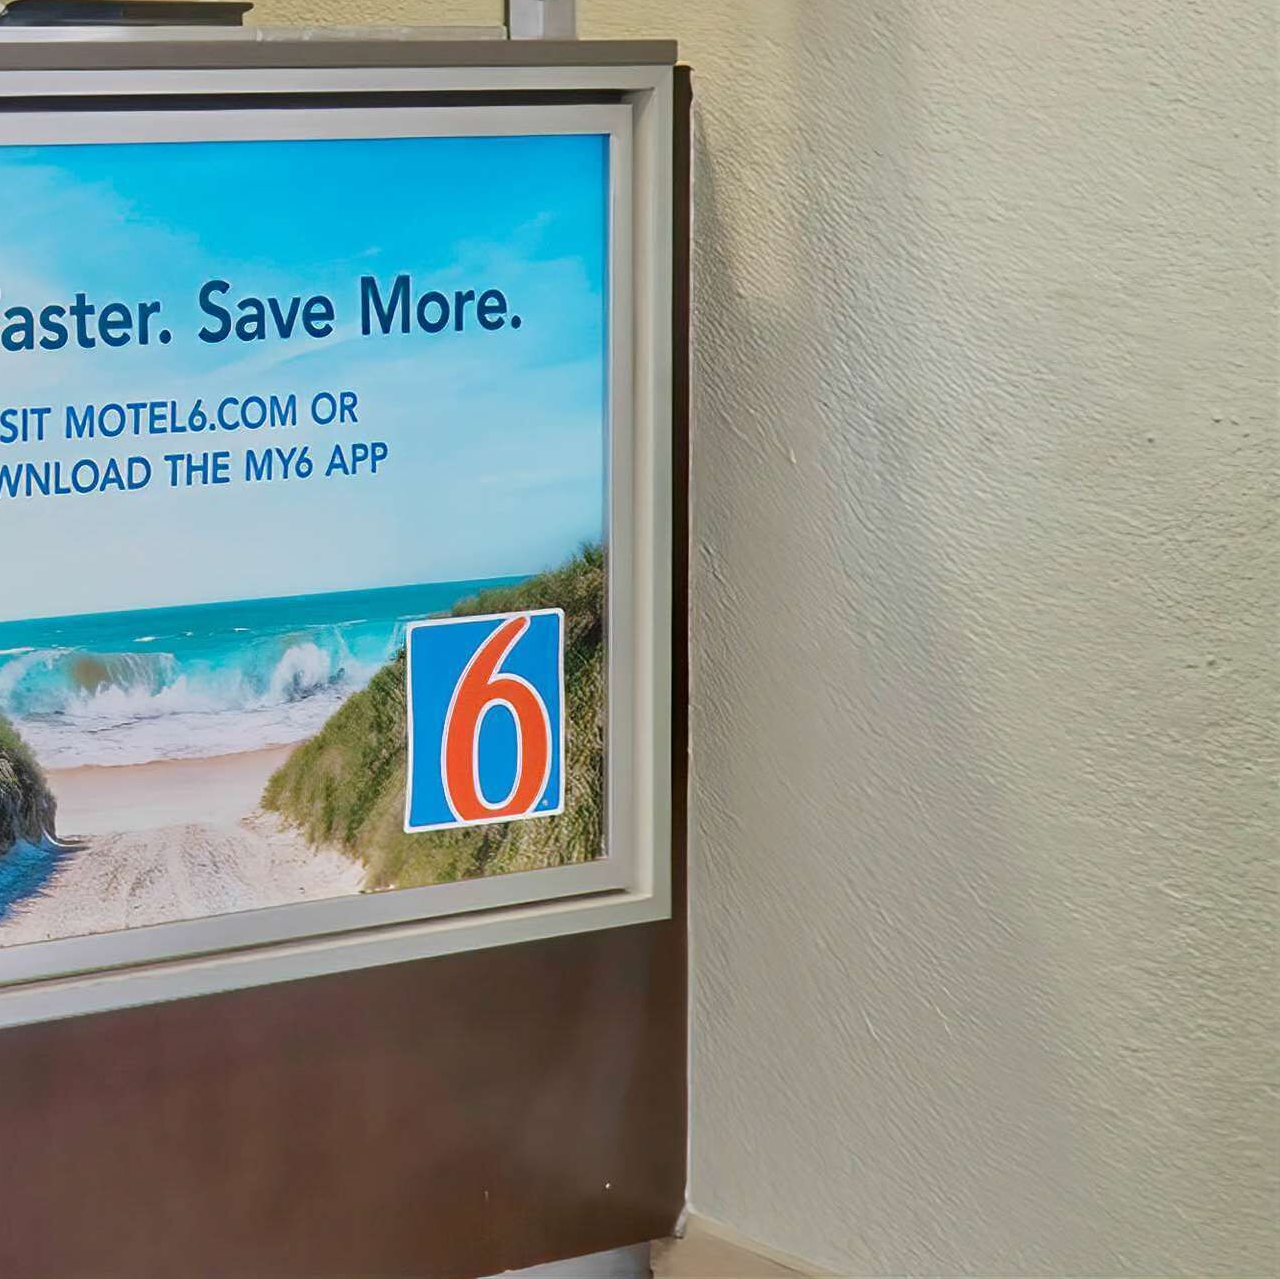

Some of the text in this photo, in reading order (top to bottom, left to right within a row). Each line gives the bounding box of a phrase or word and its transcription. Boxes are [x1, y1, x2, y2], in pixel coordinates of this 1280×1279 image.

[198, 279, 335, 344] Save
[360, 274, 522, 336] More.
[65, 394, 297, 439] MOTEL6.COM
[310, 391, 359, 426] OR
[163, 450, 231, 487] THE
[245, 445, 314, 482] MY6
[324, 441, 389, 477] APP
[441, 614, 552, 821] 6
